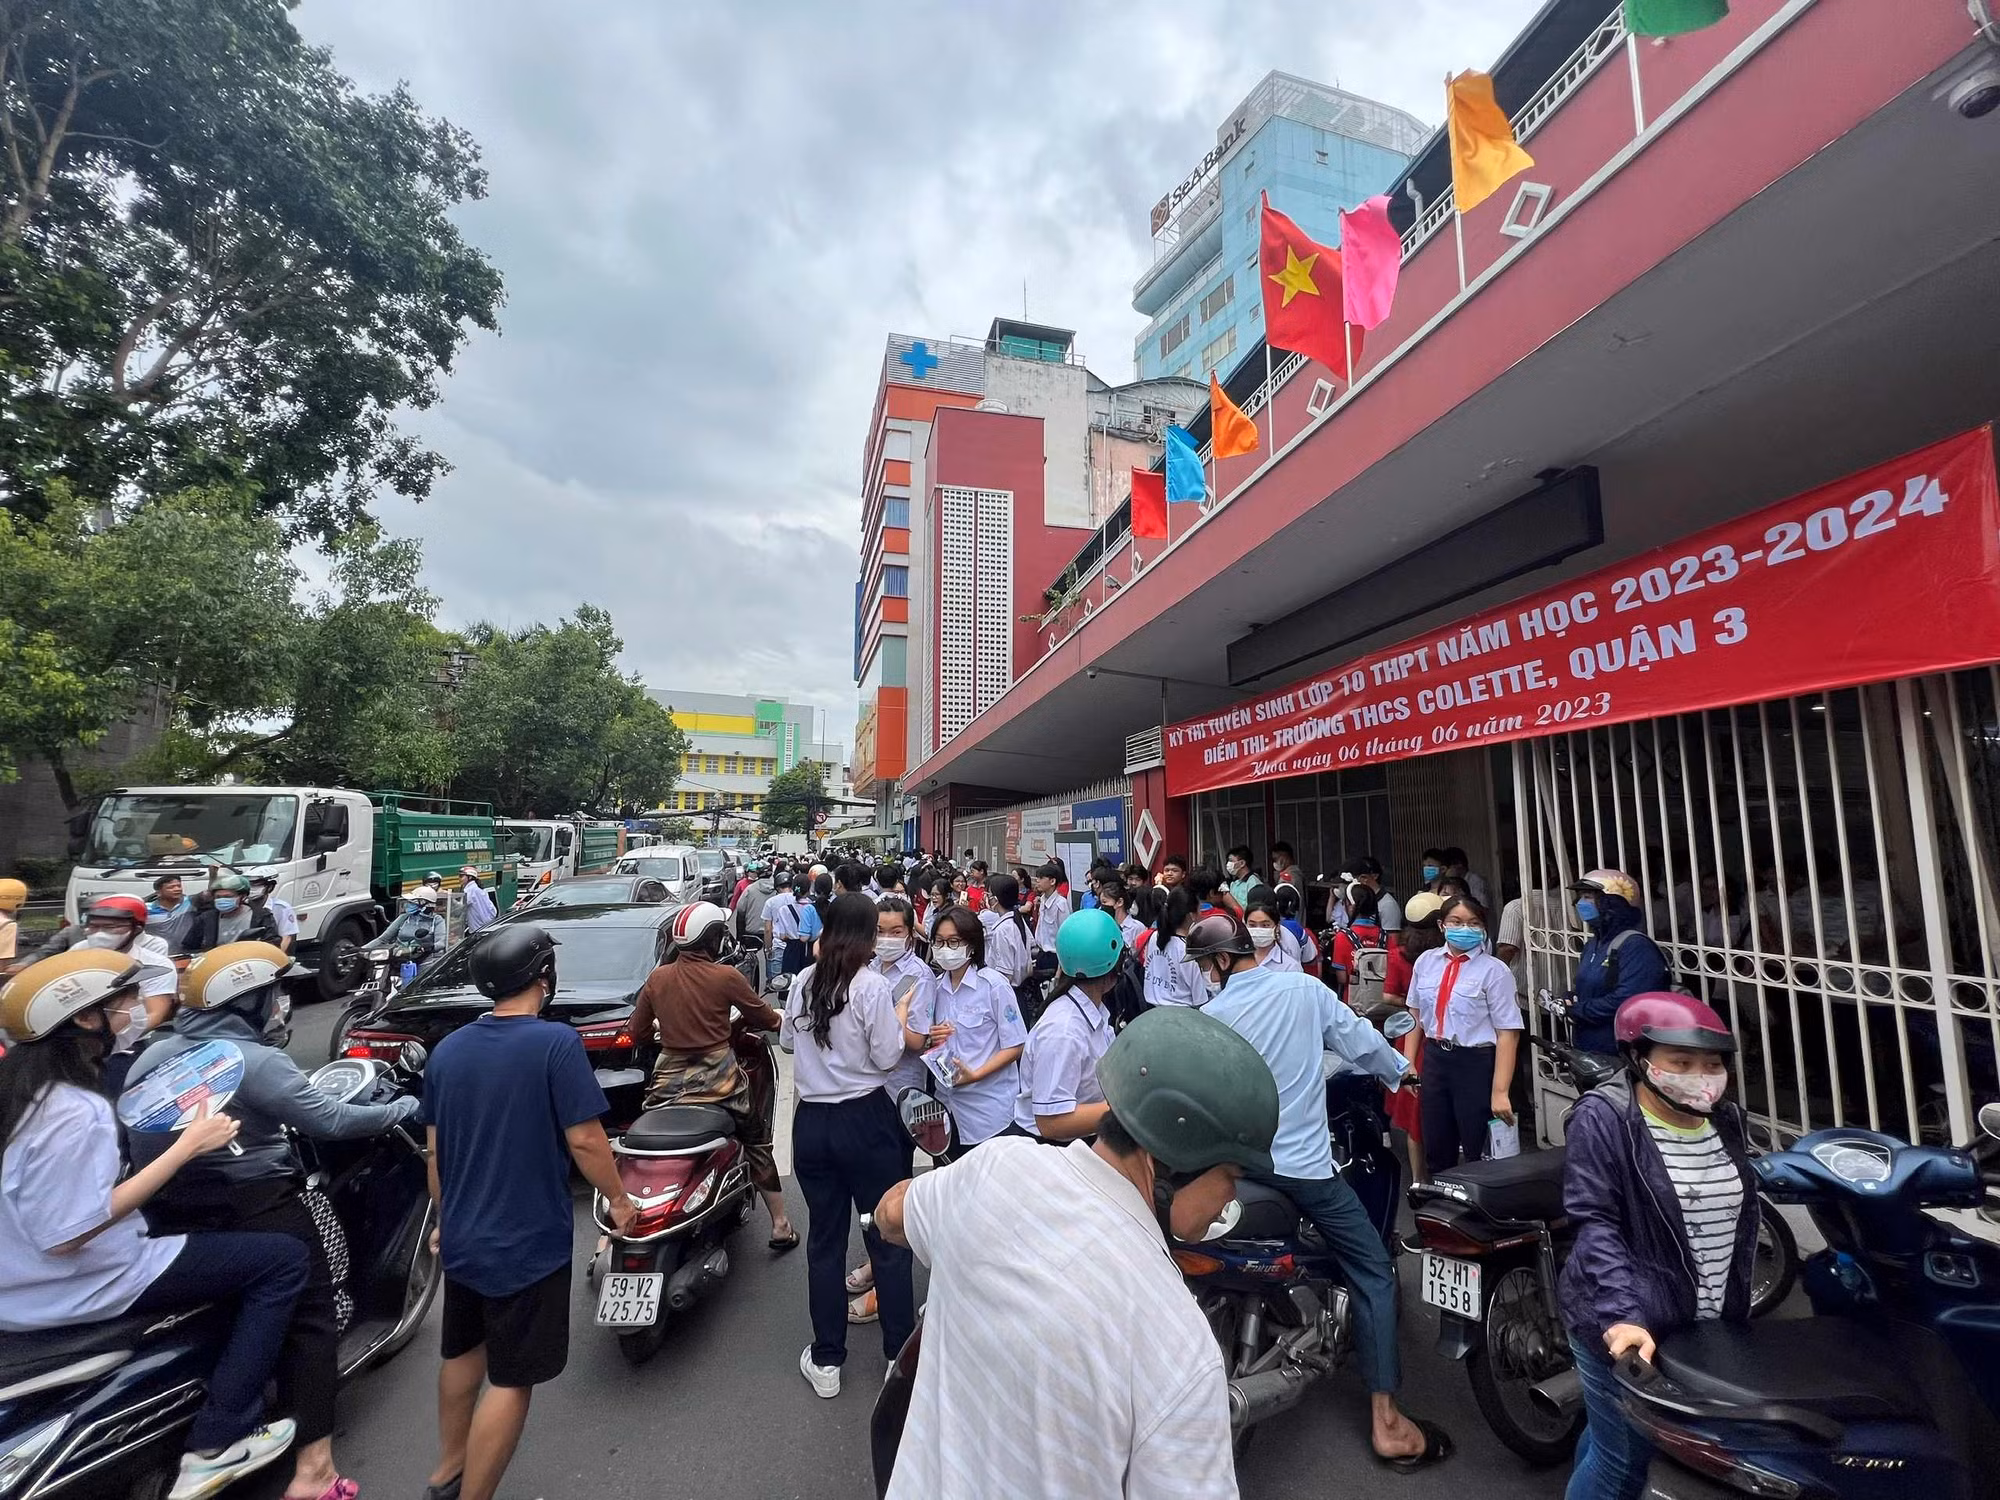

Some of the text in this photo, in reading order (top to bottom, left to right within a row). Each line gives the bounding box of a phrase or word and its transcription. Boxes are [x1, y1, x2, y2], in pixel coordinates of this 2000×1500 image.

[1171, 117, 1247, 208] SeABank
[1168, 728, 1185, 748] KỲ
[1187, 722, 1206, 744] THI
[1255, 693, 1296, 722] SINH
[1298, 680, 1334, 710] LỚP
[1339, 670, 1367, 697] 10
[1370, 647, 1430, 686] THPT
[1437, 621, 1509, 667] NĂM
[1519, 590, 1599, 642] HỌC
[1612, 473, 1950, 615] 2023-2024
[1203, 606, 1749, 766] ĐIỂM THI: TRƯỜNG THCS COLETTE, QUẬN 3
[1292, 749, 1333, 772] ngày
[1338, 744, 1361, 763] 06
[1364, 732, 1424, 759] tháng
[1431, 720, 1458, 744] 06
[1465, 707, 1523, 740] năm
[1534, 691, 1612, 727] 2023
[413, 841, 422, 853] XE
[1434, 1180, 1465, 1191] HONDA
[610, 1277, 654, 1298] 59-V2
[1429, 1255, 1469, 1288] 52-H1
[599, 1300, 655, 1322] 425.75
[1429, 1280, 1471, 1314] 1558
